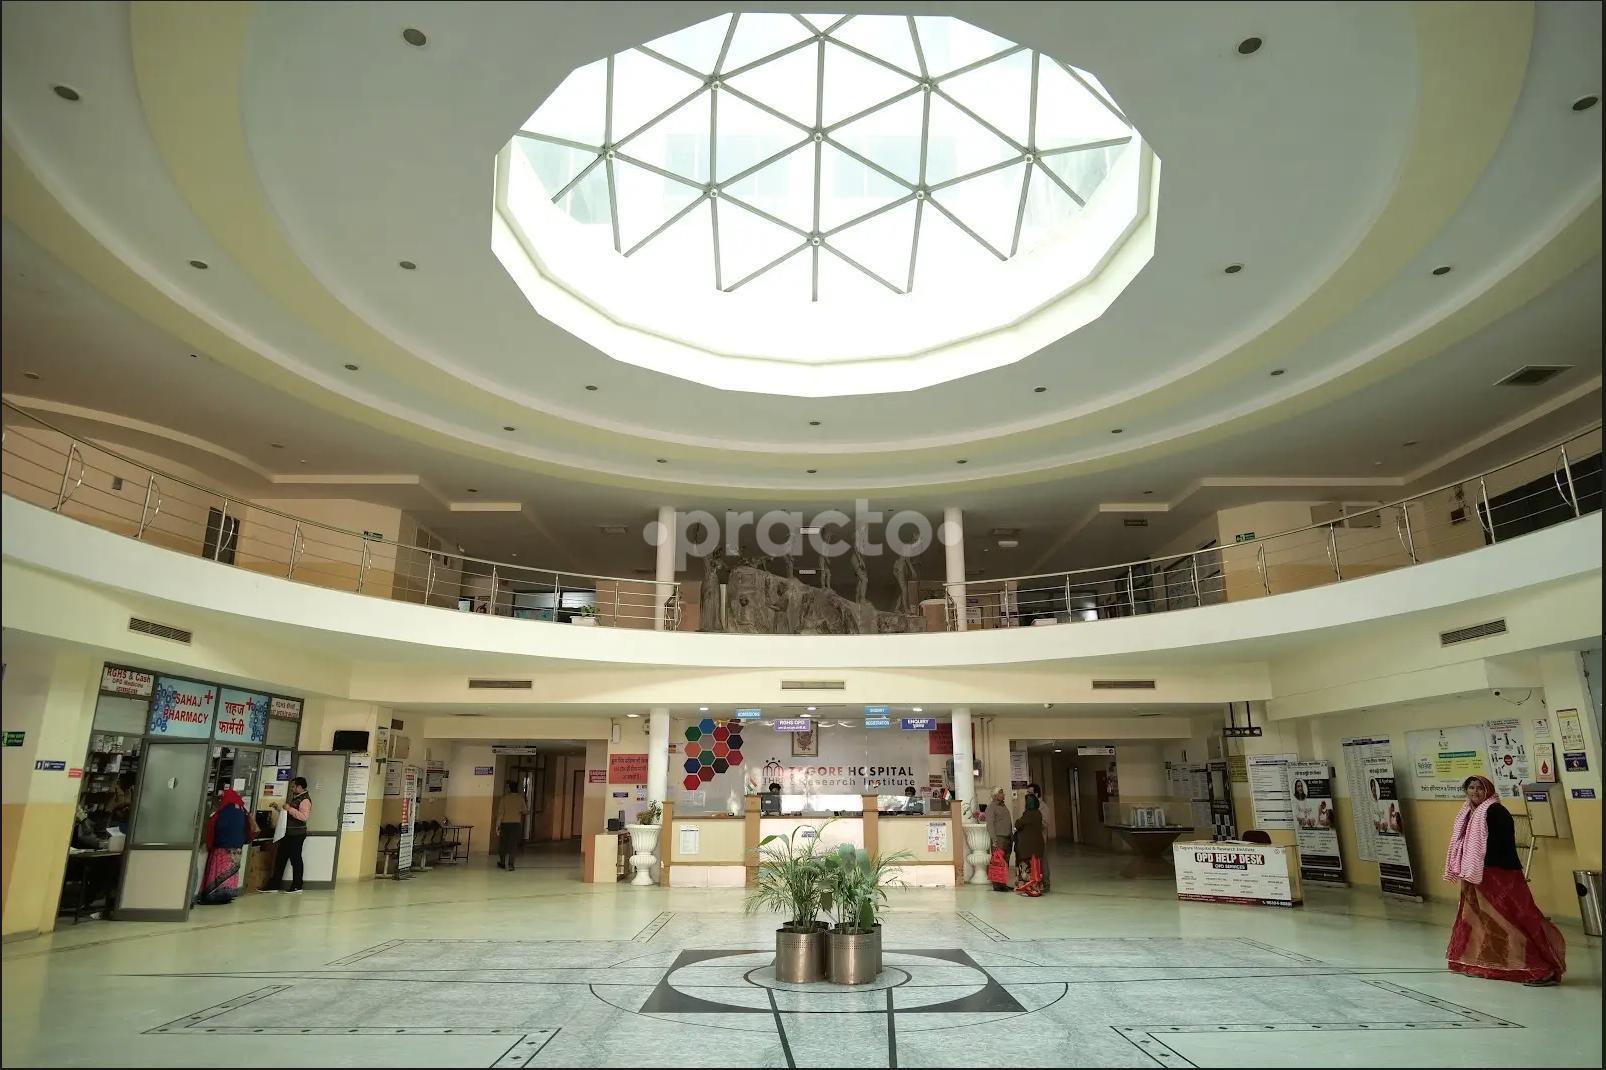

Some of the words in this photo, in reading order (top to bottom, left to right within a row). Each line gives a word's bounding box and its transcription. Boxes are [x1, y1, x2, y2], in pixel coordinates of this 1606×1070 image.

[135, 673, 151, 684] Cash
[175, 693, 203, 707] SAHAJ
[163, 708, 209, 724] PHARMACY
[789, 766, 843, 776] TGORE
[848, 766, 914, 776] HOSPITAL
[863, 777, 915, 786] Institute
[1196, 852, 1214, 863] OPD
[1215, 853, 1237, 864] HELP
[1238, 854, 1263, 865] DESK
